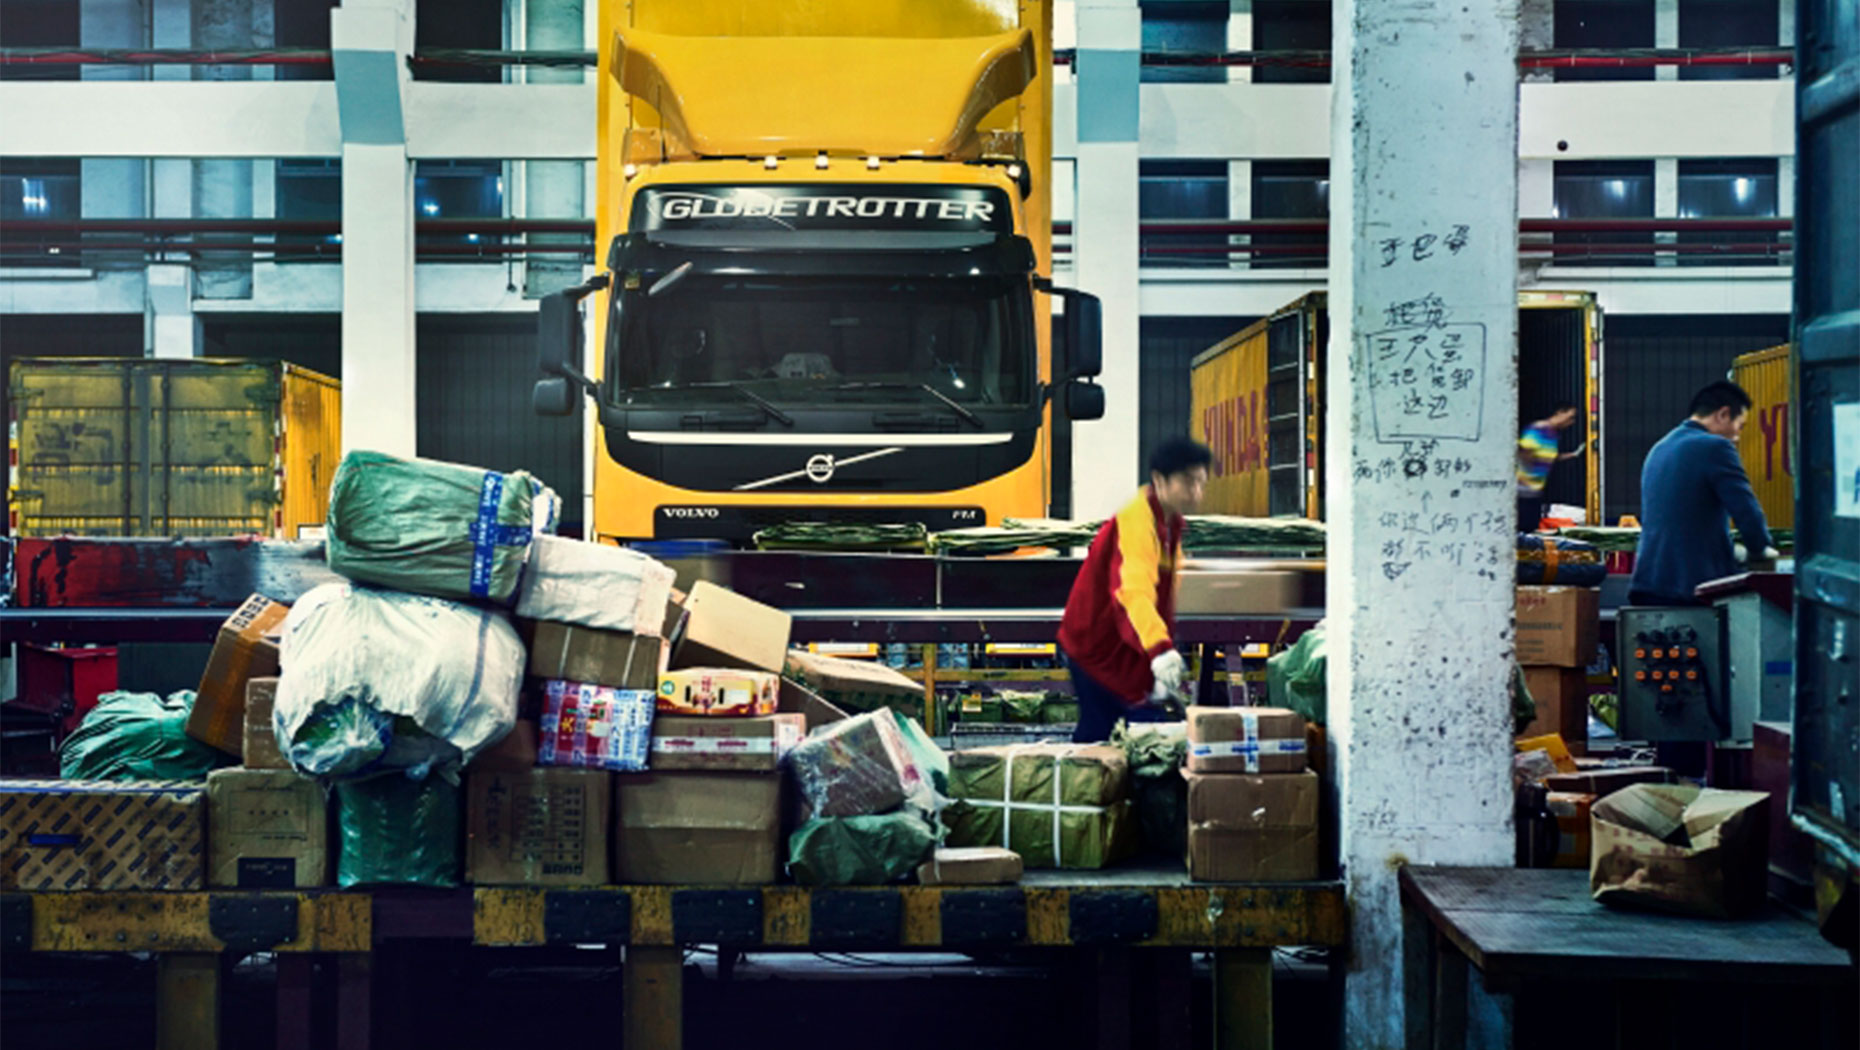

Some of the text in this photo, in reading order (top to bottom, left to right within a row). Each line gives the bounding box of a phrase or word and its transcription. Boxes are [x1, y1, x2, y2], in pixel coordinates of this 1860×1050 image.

[662, 196, 995, 222] GLOBETROTTER
[1402, 388, 1449, 420] 这边
[663, 507, 720, 519] VOLVO
